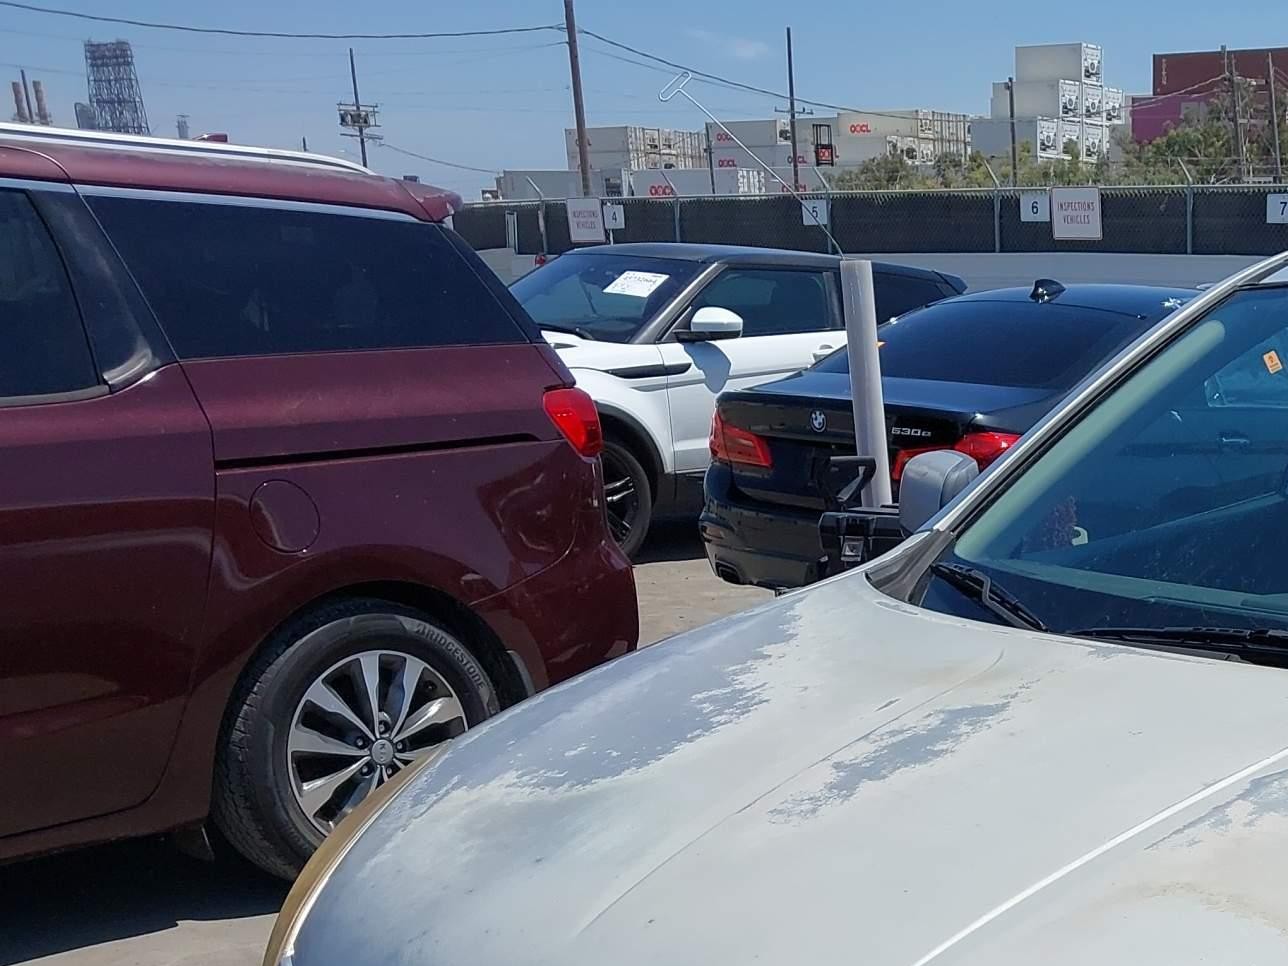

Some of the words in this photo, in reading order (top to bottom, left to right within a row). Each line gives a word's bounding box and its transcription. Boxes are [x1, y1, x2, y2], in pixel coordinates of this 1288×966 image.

[812, 206, 819, 218] 5
[1031, 200, 1039, 215] 6
[1057, 201, 1096, 211] INSPECTIONS
[1280, 201, 1288, 216] 7
[611, 210, 618, 223] 4
[1063, 214, 1090, 225] VEHICLES
[416, 623, 485, 689] BRIDGESTONE
